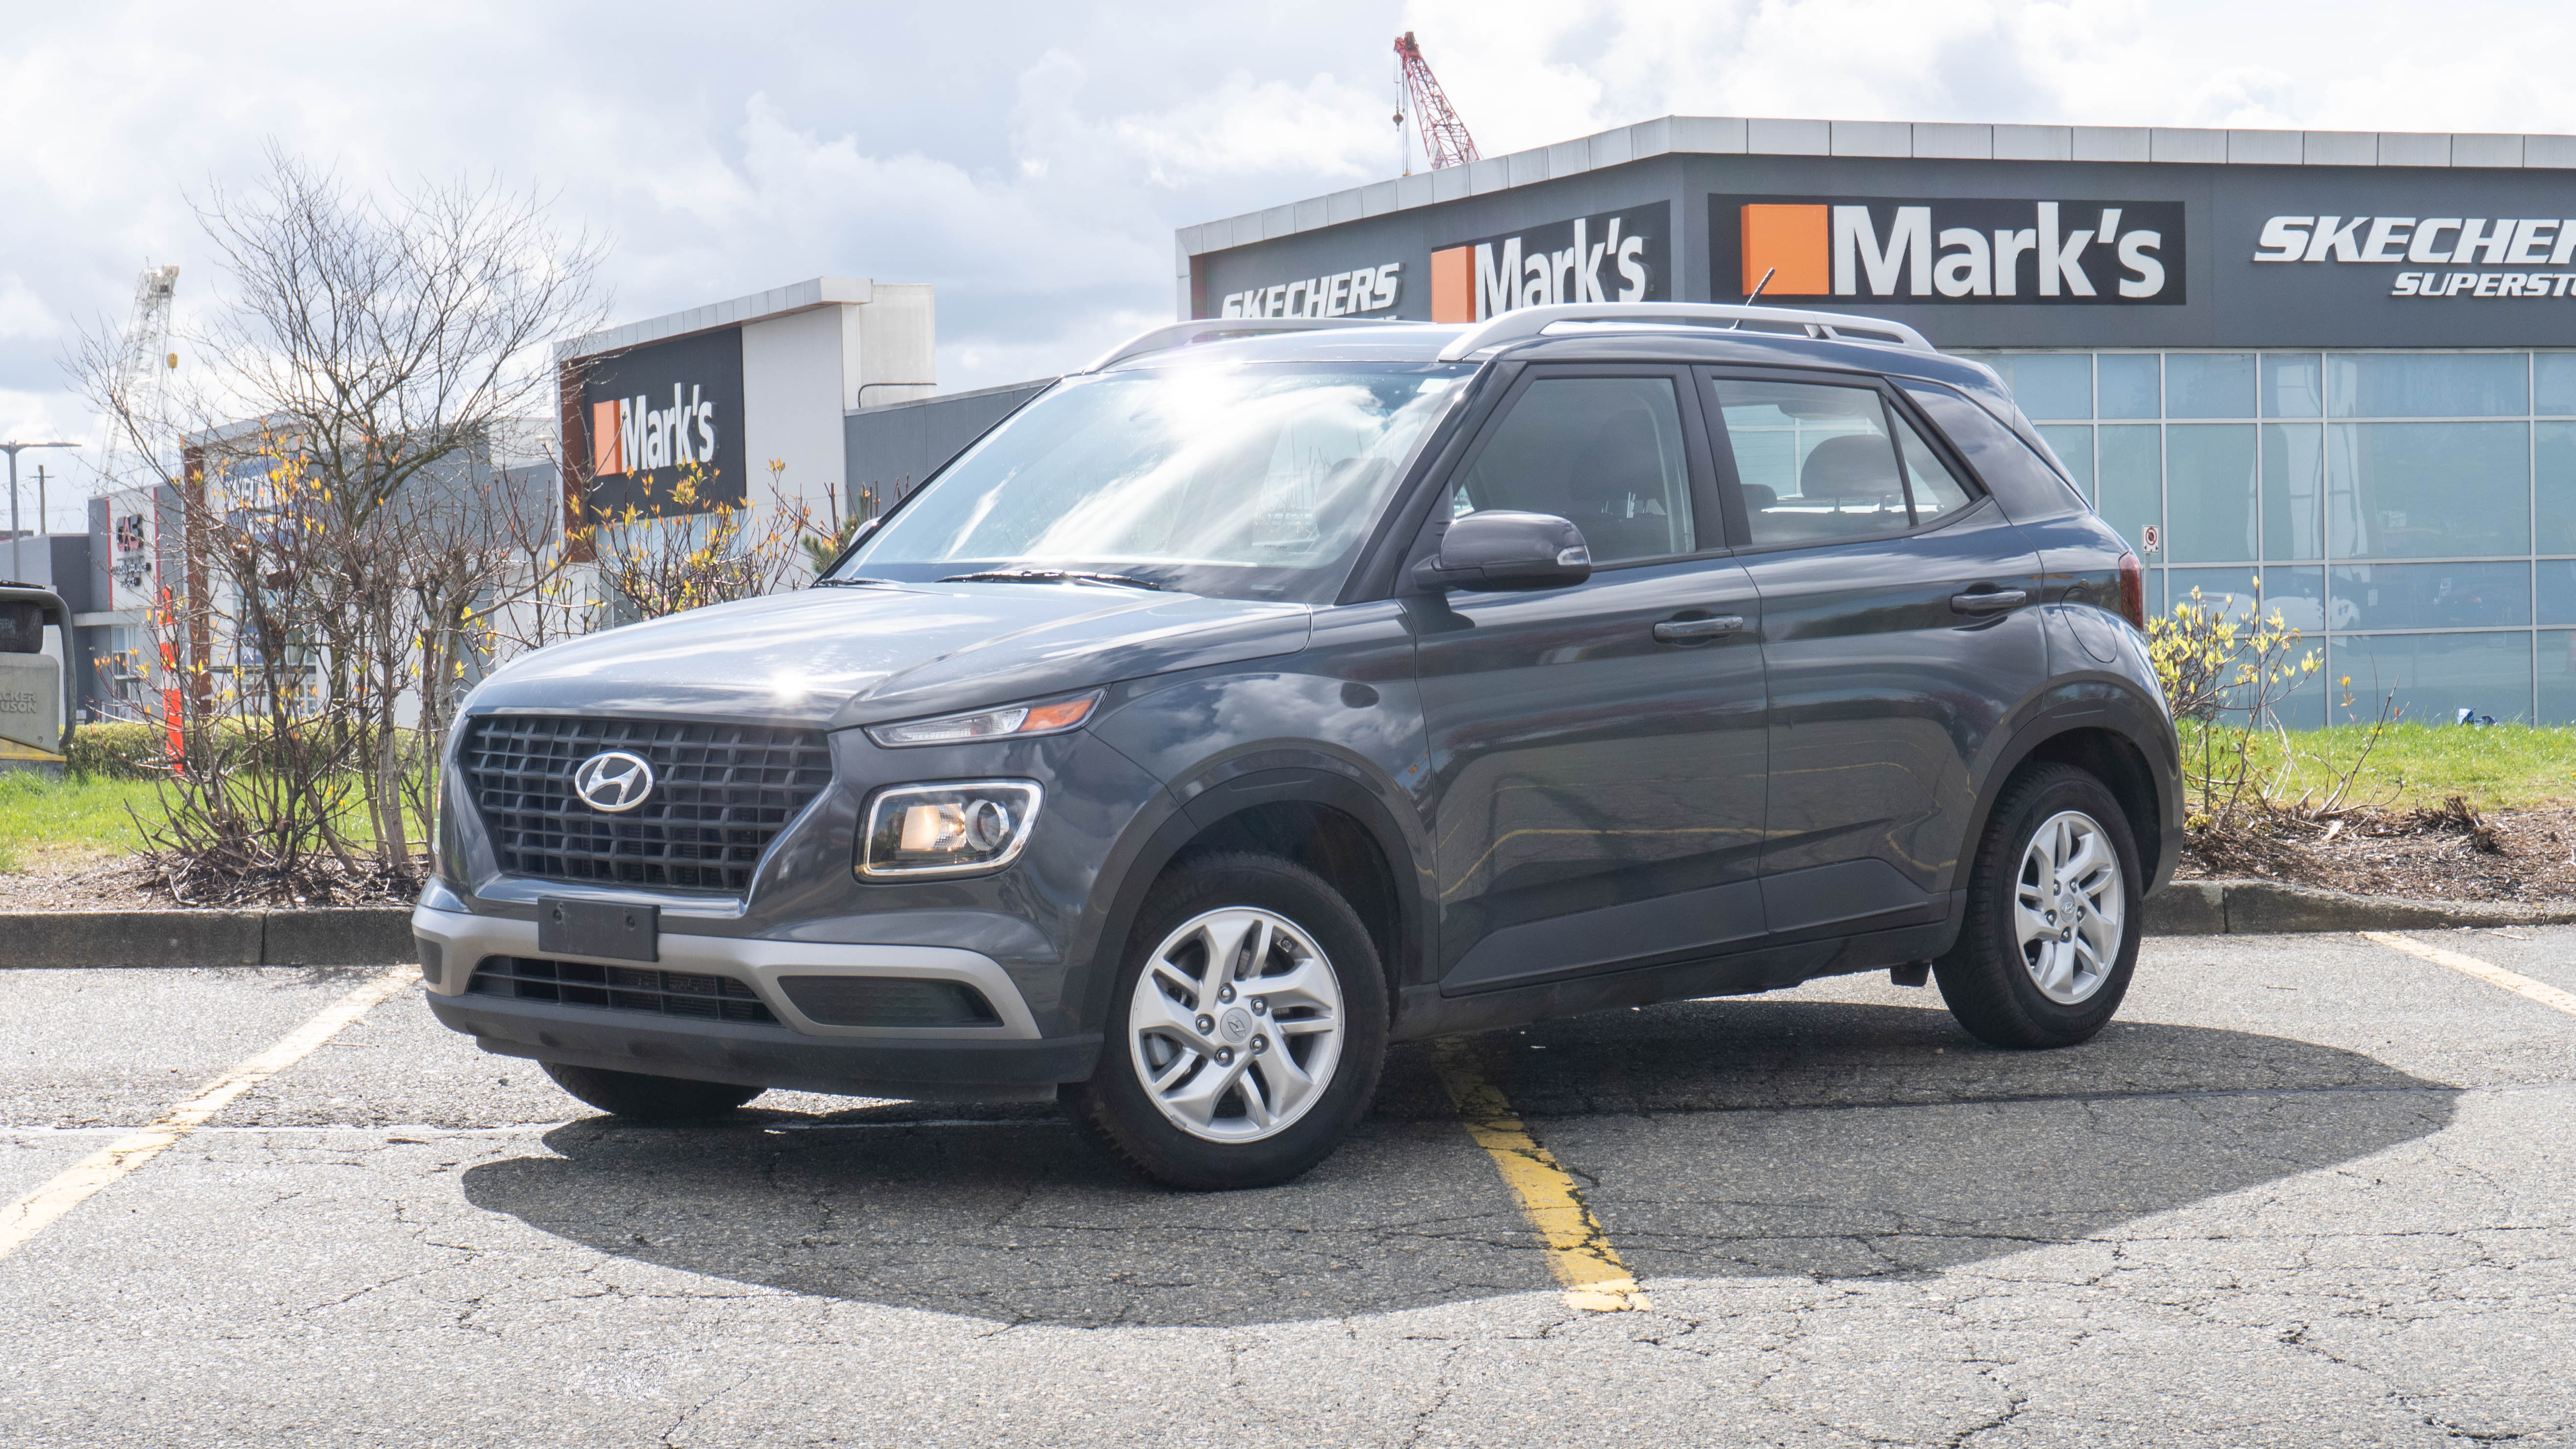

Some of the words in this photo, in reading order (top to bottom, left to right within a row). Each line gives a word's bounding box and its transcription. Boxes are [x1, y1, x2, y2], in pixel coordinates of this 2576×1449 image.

[1222, 262, 1400, 319] SKECHERS
[1475, 217, 1646, 323] Mark's
[1833, 201, 2166, 298] Mark's
[2391, 272, 2576, 297] SUPERST
[619, 382, 714, 473] Mark's
